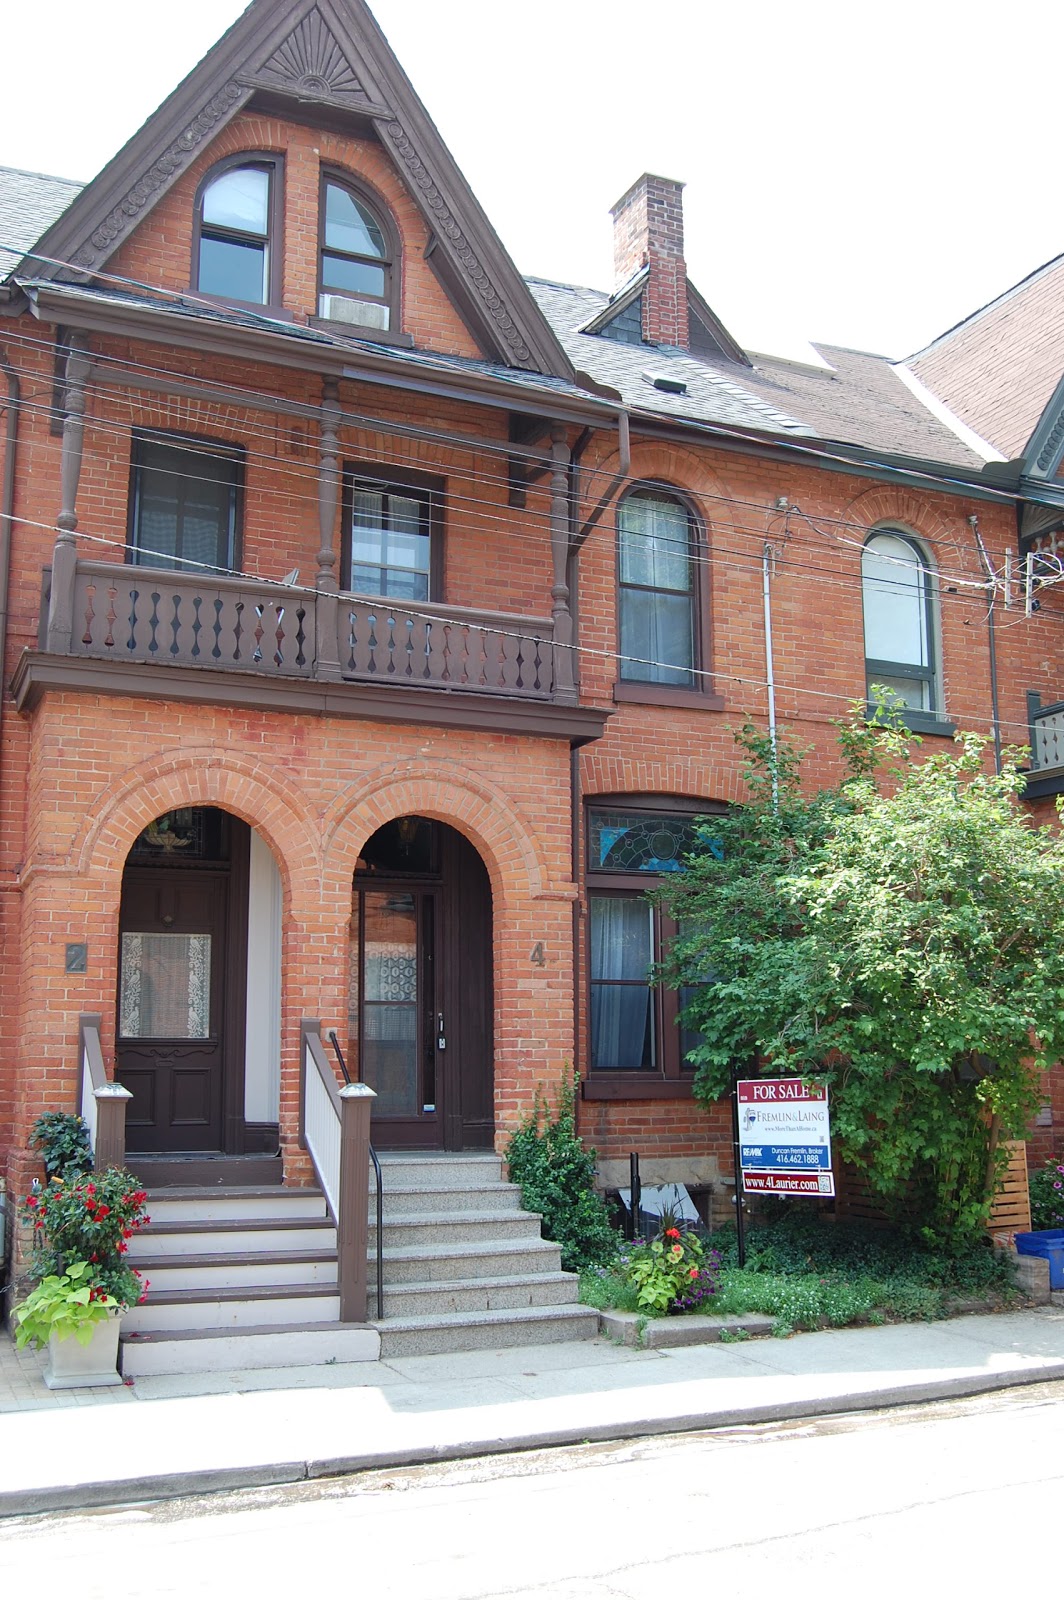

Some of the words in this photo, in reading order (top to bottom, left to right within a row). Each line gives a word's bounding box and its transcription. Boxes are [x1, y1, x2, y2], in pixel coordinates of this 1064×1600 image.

[66, 944, 86, 972] 2
[530, 942, 546, 967] 4
[753, 1085, 777, 1100] FOR
[778, 1084, 810, 1099] SALE
[757, 1110, 825, 1122] FREMLIN&LAING
[808, 1147, 824, 1155] Broker
[776, 1154, 820, 1164] 416.462.1888
[745, 1176, 818, 1191] www.4Laurier.com
